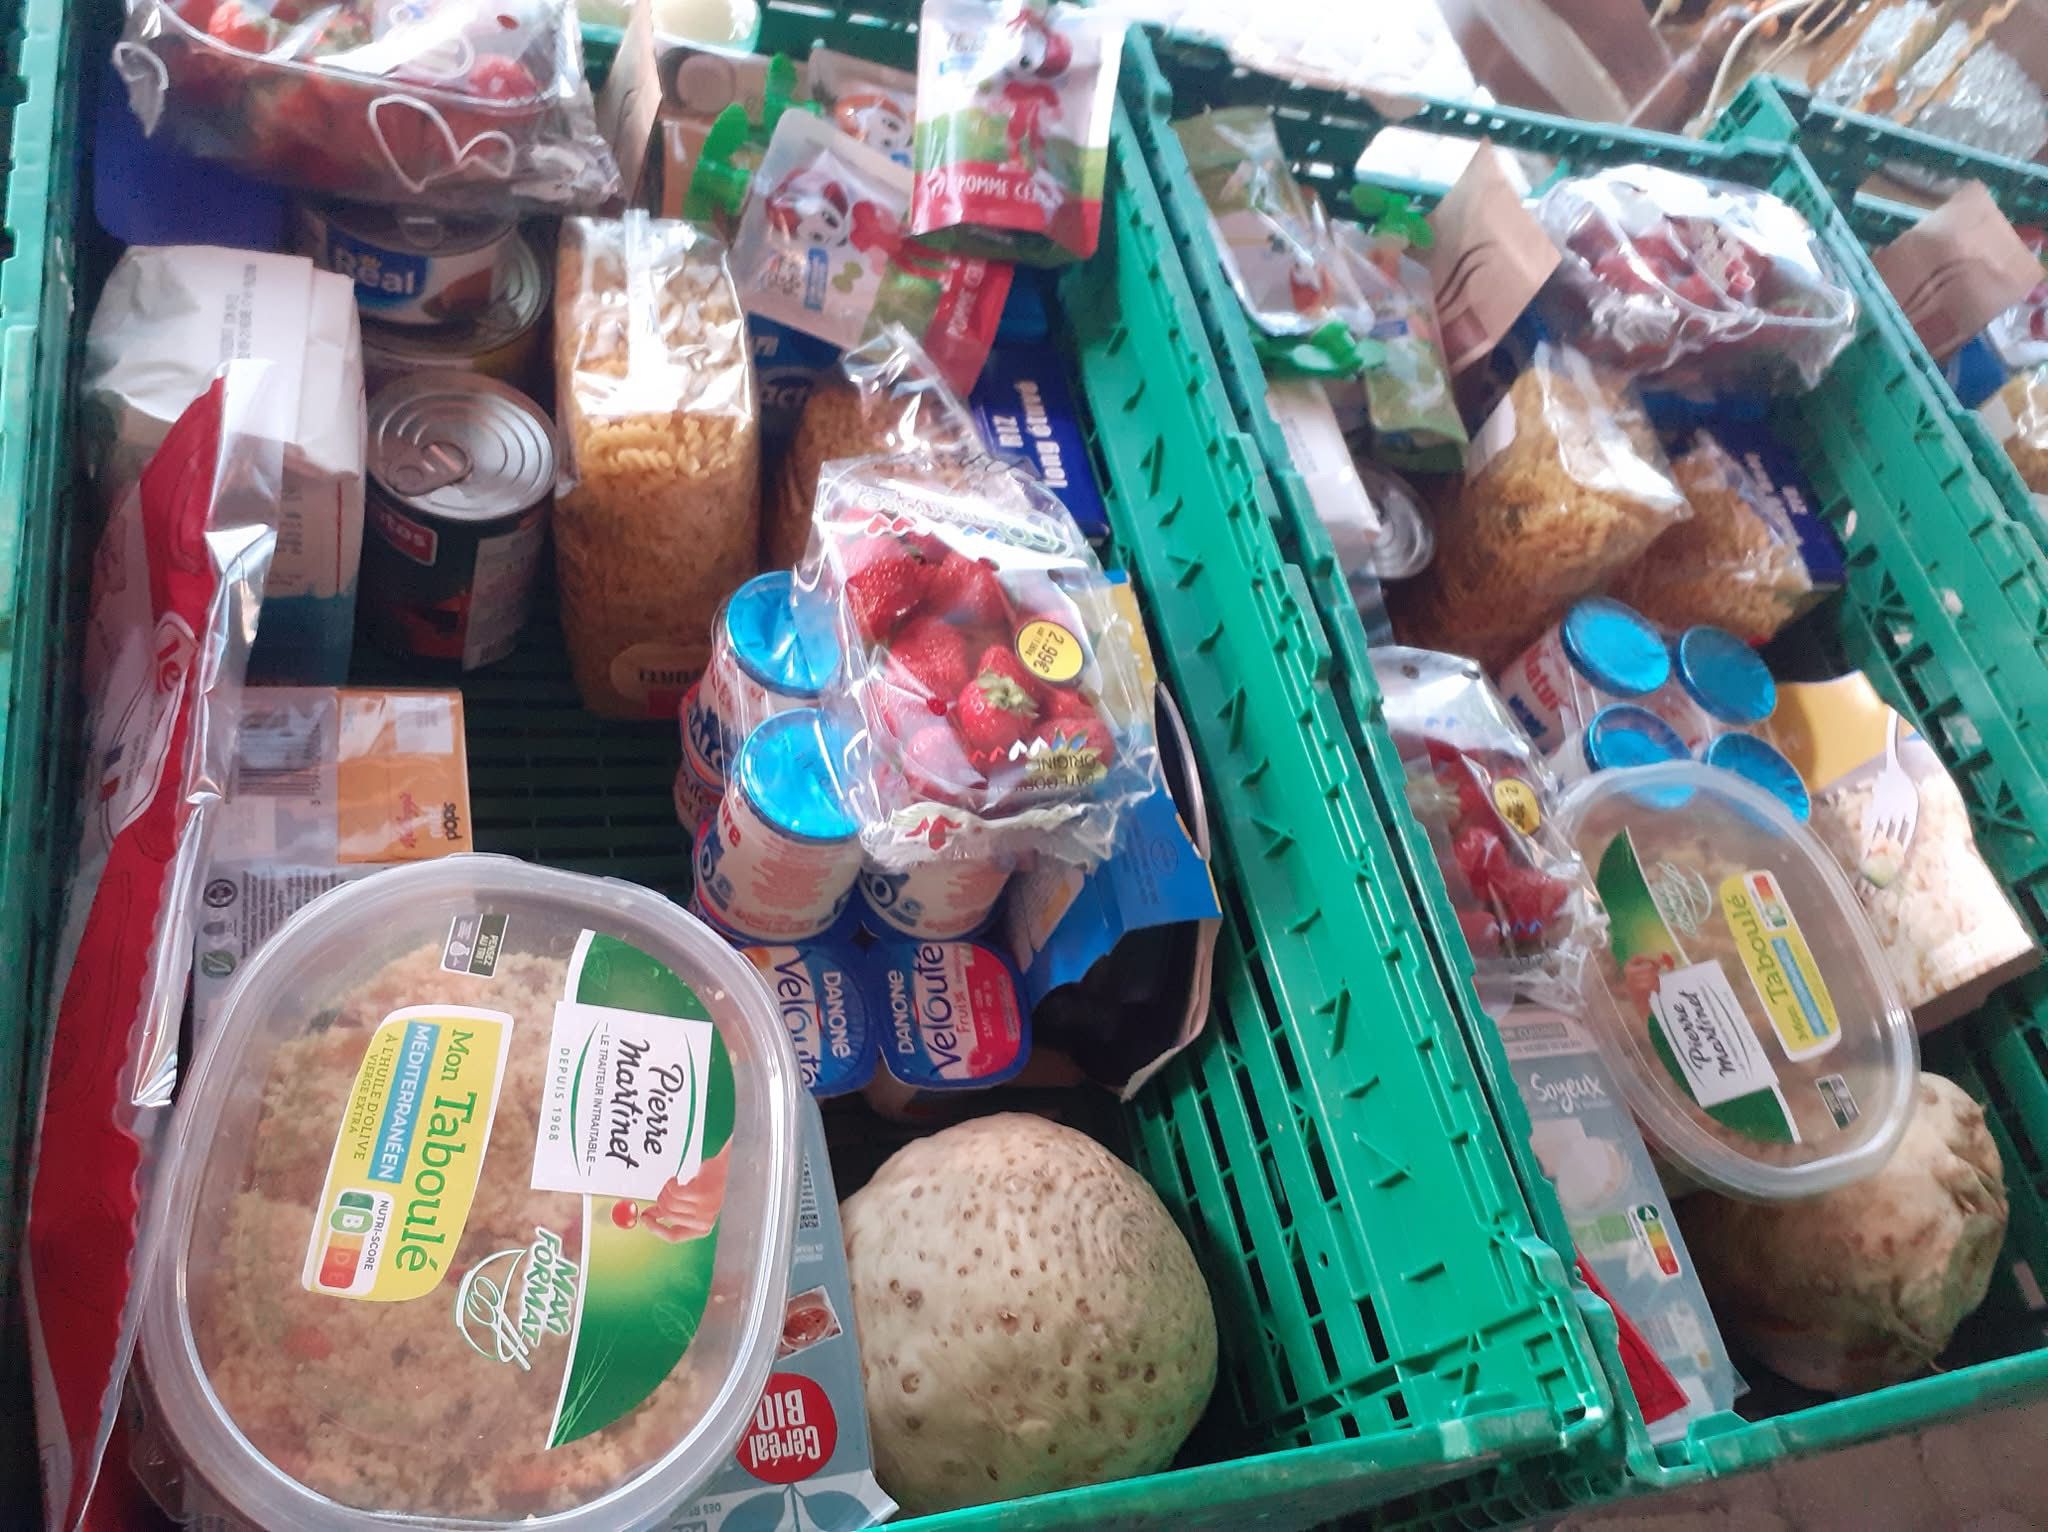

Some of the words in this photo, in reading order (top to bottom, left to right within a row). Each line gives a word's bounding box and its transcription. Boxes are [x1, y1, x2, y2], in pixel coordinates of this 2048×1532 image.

[1033, 631, 1065, 673] 2.99€
[822, 970, 850, 1058] DANONE
[888, 969, 915, 1054] DANONE
[914, 942, 962, 1076] Velouté
[1672, 1001, 1712, 1070] Pierre
[440, 1028, 475, 1082] Mon
[599, 1033, 611, 1048] LE
[358, 1052, 379, 1095] VIERGE
[371, 1047, 395, 1102] L'HUILE
[554, 1047, 571, 1100] DEPUIS
[595, 1049, 610, 1097] TRAITEUR
[1529, 1071, 1607, 1114] Soyeux
[348, 1095, 368, 1135] EXTRA
[376, 1024, 434, 1180] MÉDITERRANÉEN
[547, 1106, 562, 1142] 1968
[643, 1062, 685, 1156] Pierre
[353, 1102, 379, 1161] D'OLIVE
[586, 1098, 605, 1164] INTRAITABLE
[394, 1091, 478, 1272] Taboulé
[341, 1212, 366, 1229] B
[363, 1199, 389, 1272] NUTRI-SCORE
[1644, 1205, 1656, 1220] A
[522, 1228, 562, 1347] FORMAT
[546, 1257, 580, 1335] MAXI
[755, 1388, 807, 1431] BIO
[749, 1425, 822, 1469] Céréal
